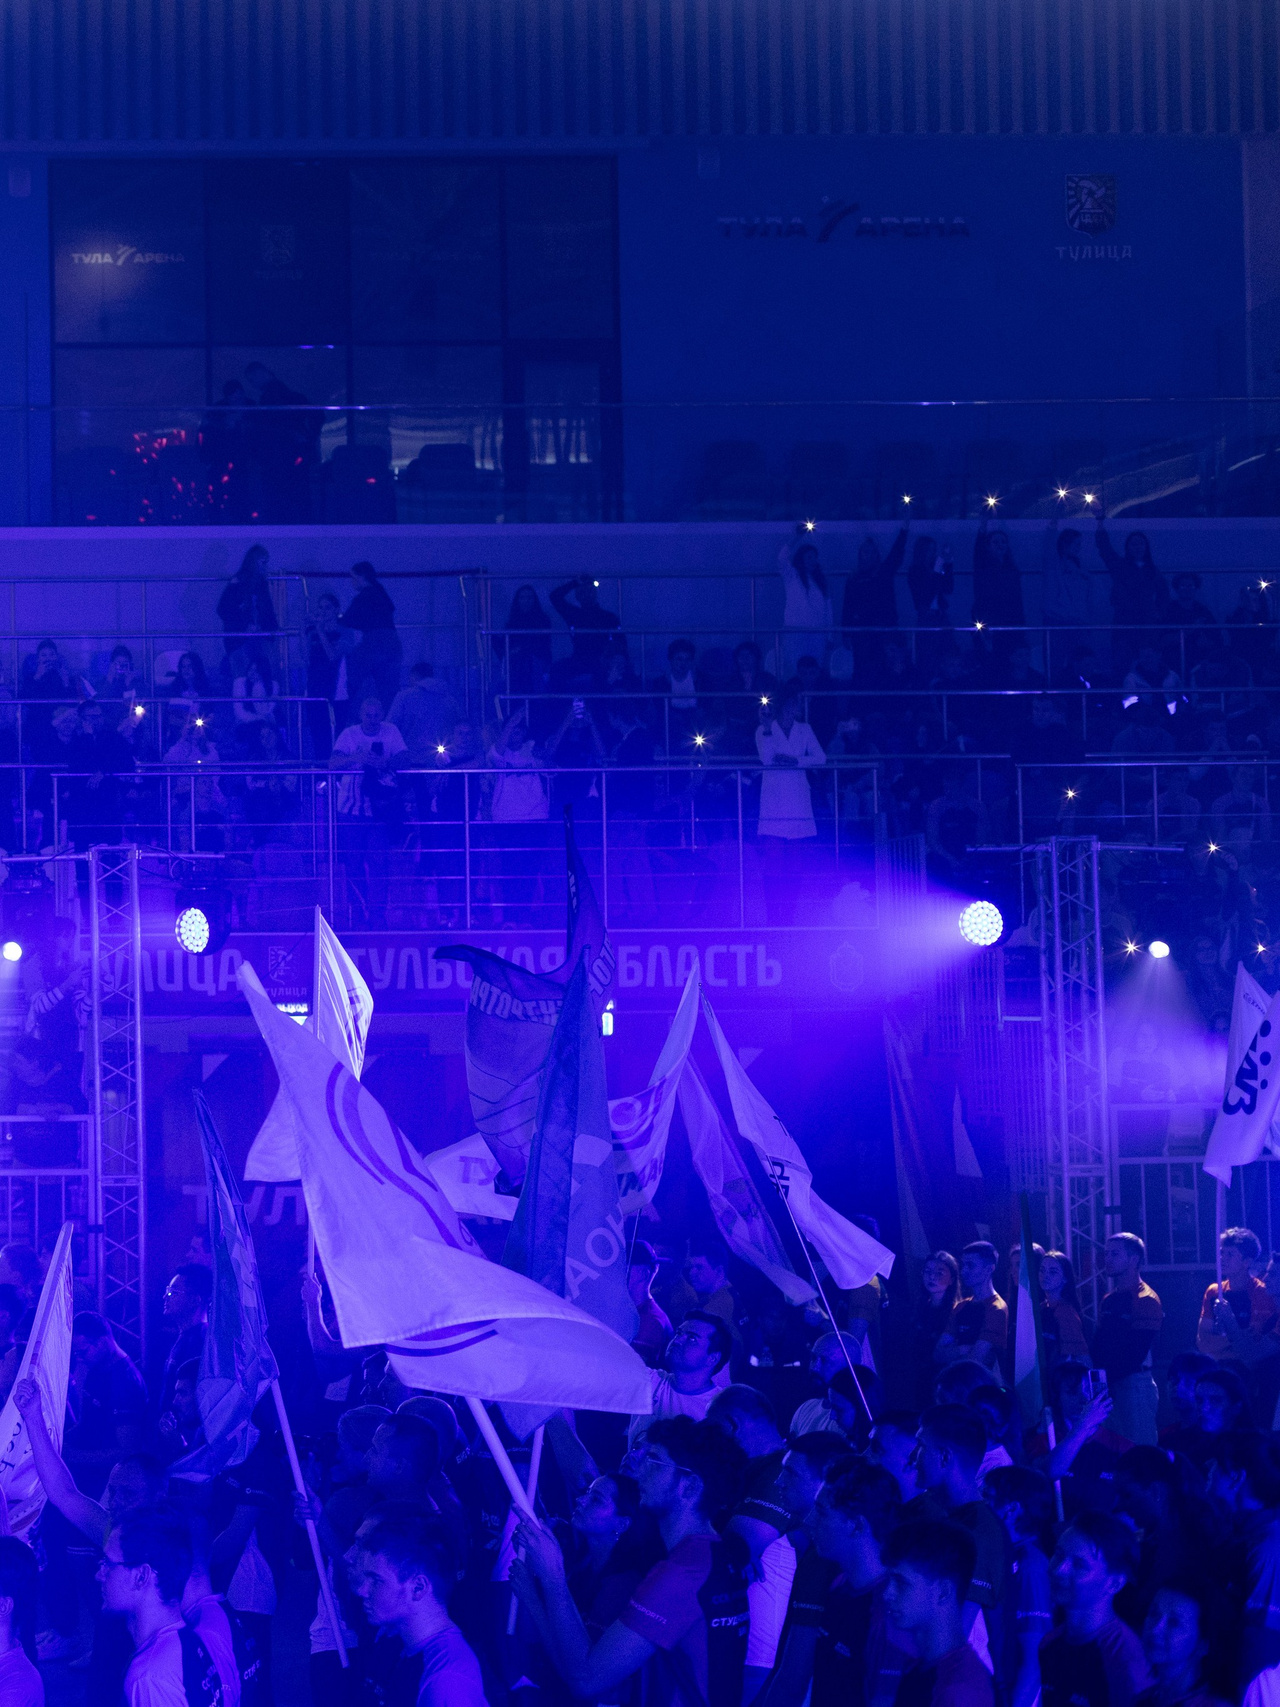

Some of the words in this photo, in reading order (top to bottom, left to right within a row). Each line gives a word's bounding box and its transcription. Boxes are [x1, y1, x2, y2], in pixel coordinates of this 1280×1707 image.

[717, 215, 808, 240] ТУЛА
[854, 215, 971, 239] АРЕНА
[71, 252, 113, 265] ТУЛА
[1054, 244, 1133, 262] ТУЛИЦА
[617, 944, 782, 988] БЛАСТЬ
